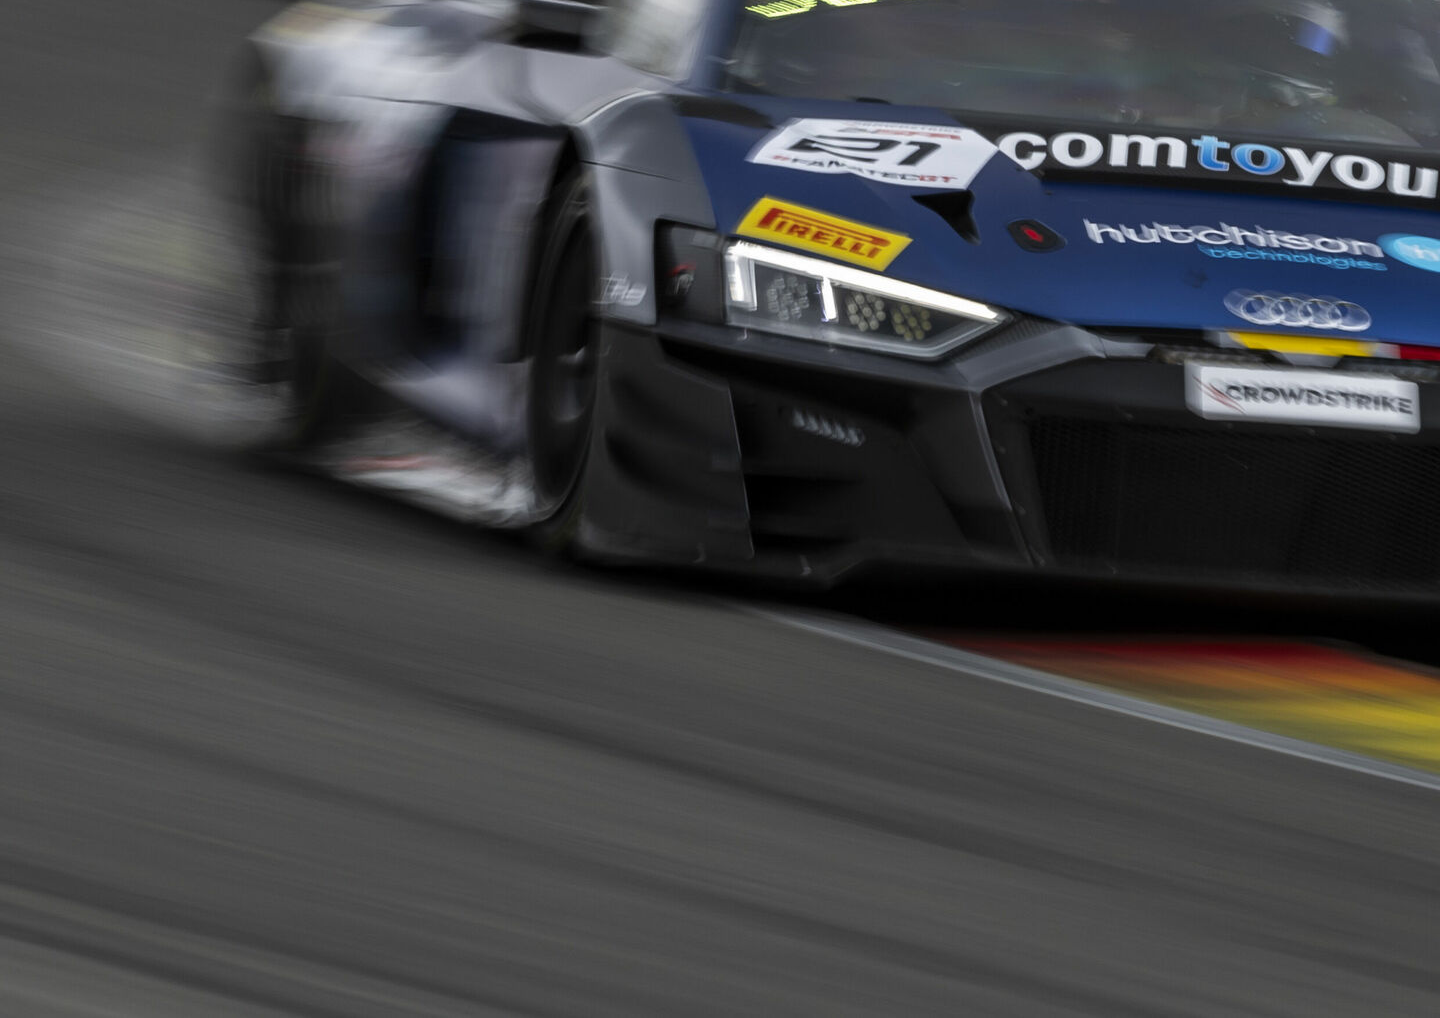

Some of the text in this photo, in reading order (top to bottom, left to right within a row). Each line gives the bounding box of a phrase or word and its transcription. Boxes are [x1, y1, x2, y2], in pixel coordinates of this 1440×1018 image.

[787, 134, 942, 167] 21
[998, 132, 1439, 199] comtoyou
[756, 207, 893, 260] PIRELLI
[1083, 218, 1385, 258] hutchison
[1198, 244, 1388, 272] technologies
[1225, 380, 1414, 416] CROWDSTRIKE
